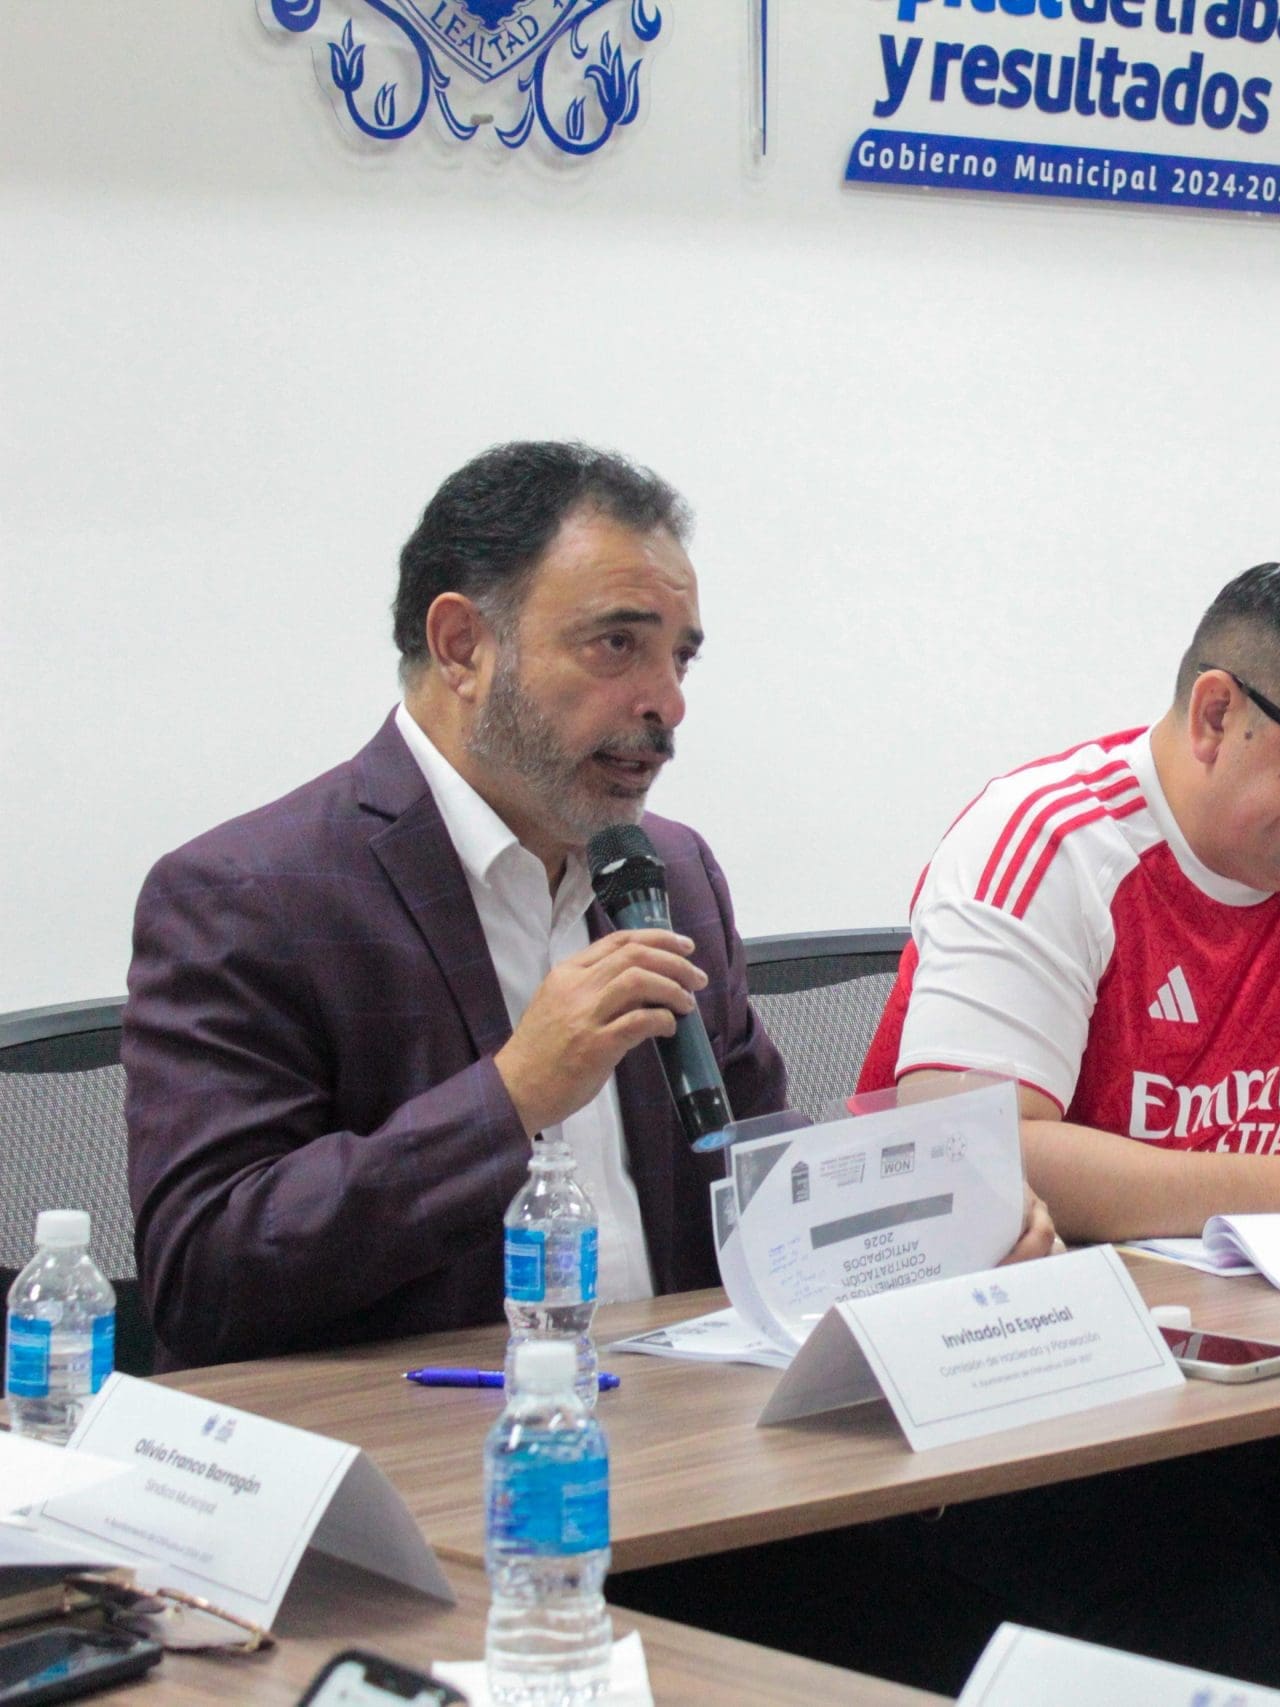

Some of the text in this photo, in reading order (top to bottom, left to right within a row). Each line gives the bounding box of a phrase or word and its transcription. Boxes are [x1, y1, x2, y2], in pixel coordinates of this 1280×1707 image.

[430, 1, 539, 68] LEALTAD
[873, 34, 1273, 134] y resultados
[858, 140, 998, 178] Gobierno
[1014, 154, 1157, 195] Municipal
[884, 1160, 910, 1174] NOM
[843, 1240, 919, 1272] ANTICIPADOS
[864, 1232, 894, 1250] 2026
[1016, 1306, 1074, 1333] Especial
[135, 1438, 262, 1495] Olivia Franco Barragán
